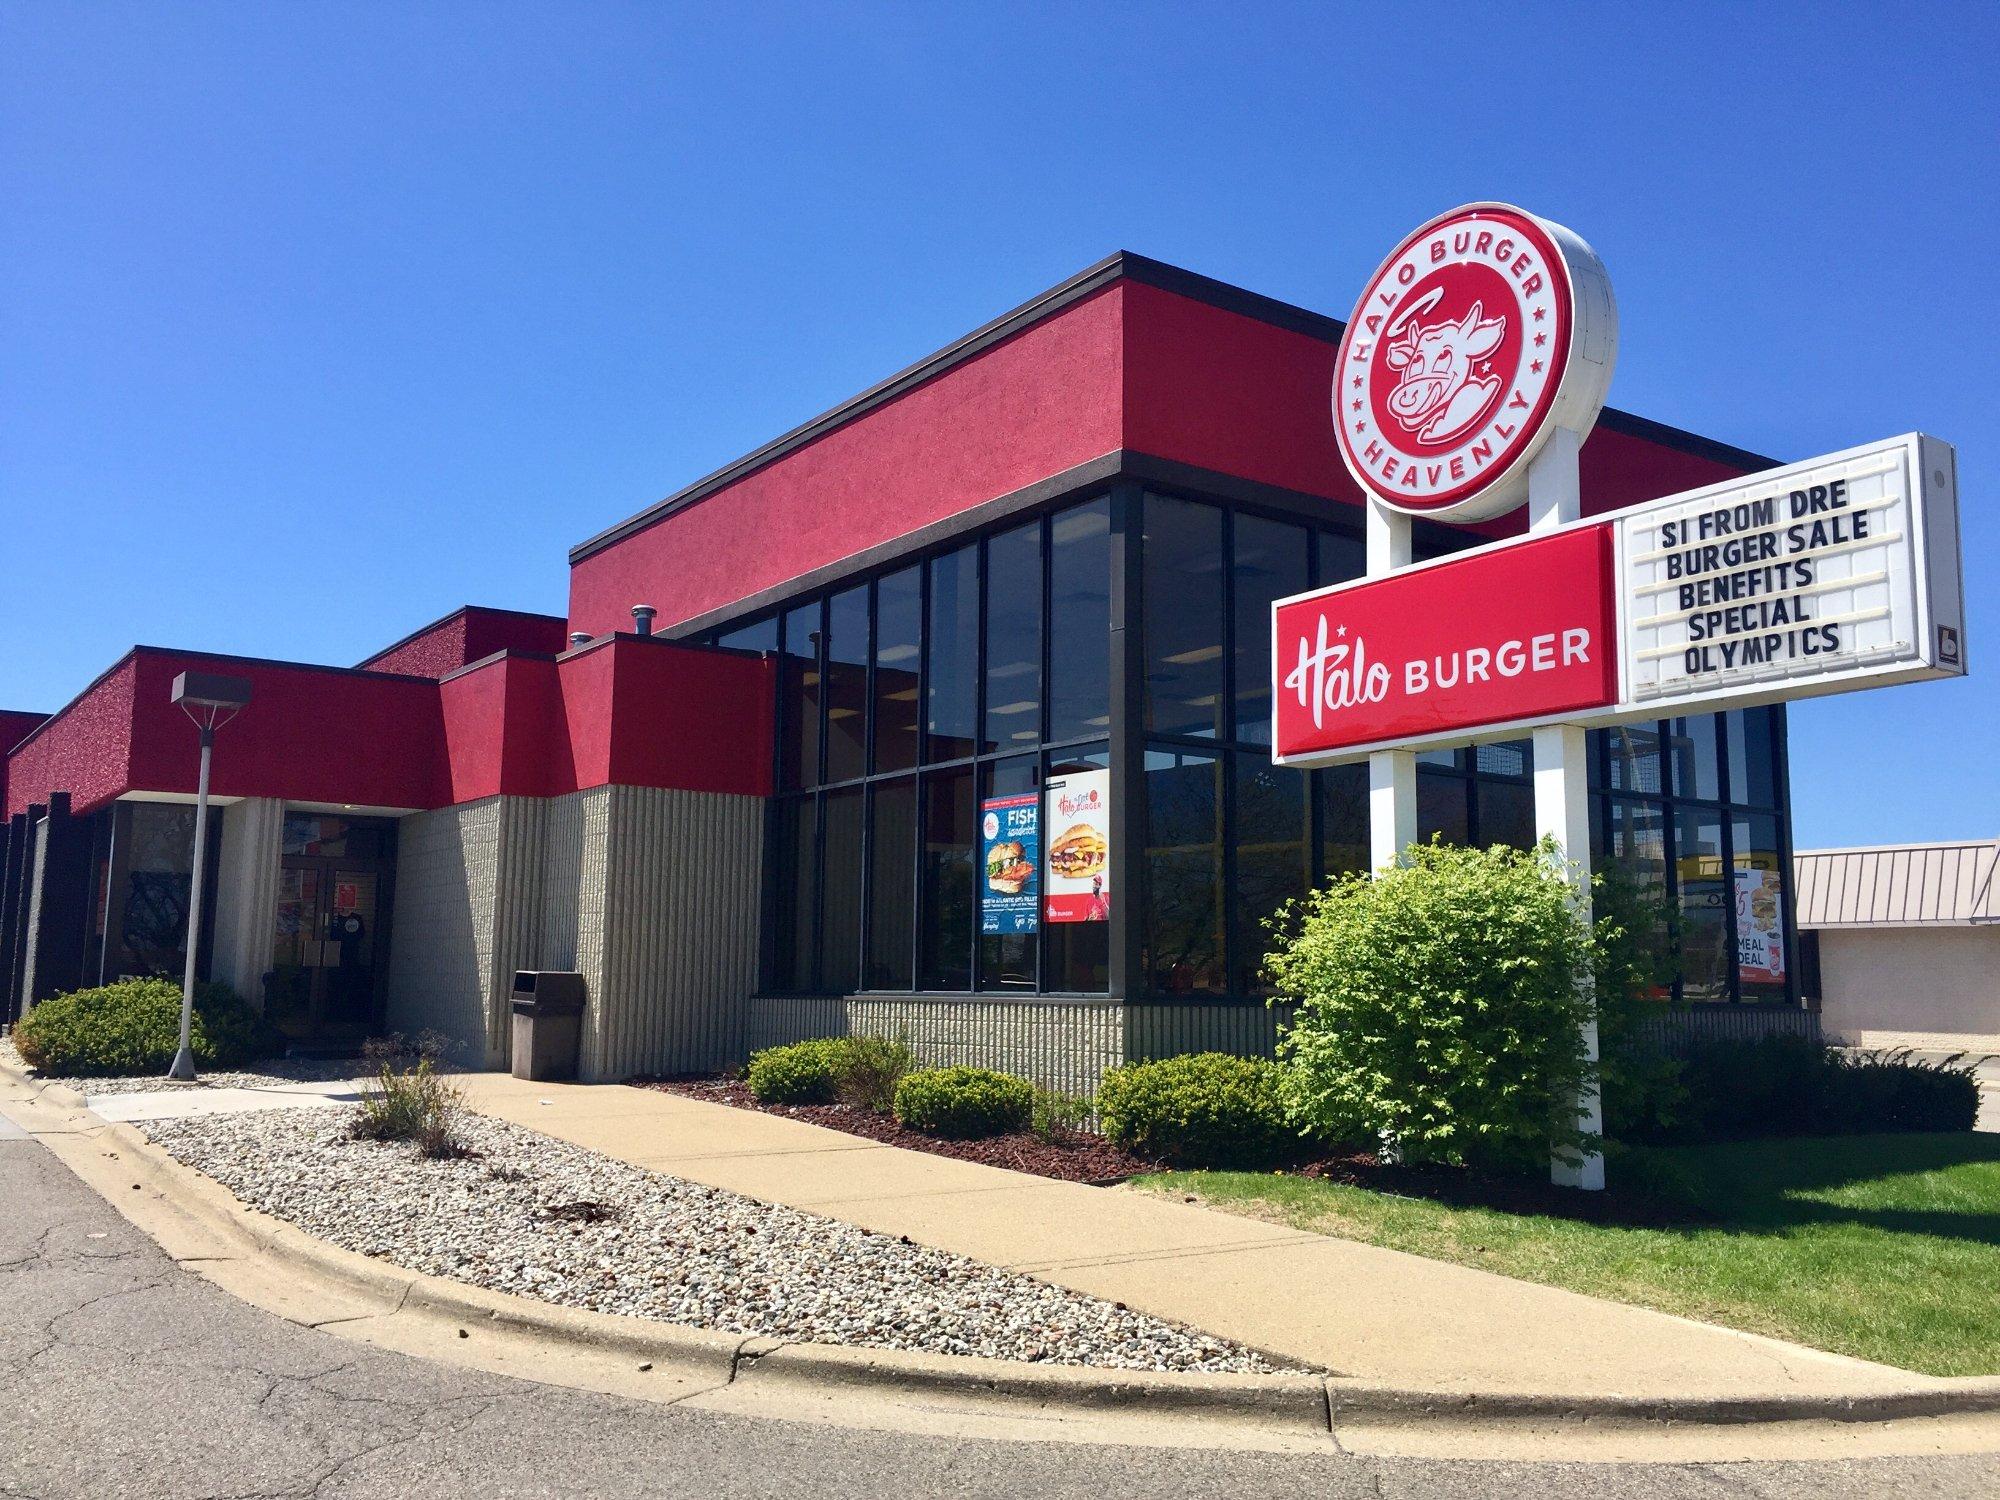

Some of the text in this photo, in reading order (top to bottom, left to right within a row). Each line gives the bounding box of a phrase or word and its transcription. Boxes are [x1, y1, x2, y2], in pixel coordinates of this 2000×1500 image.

[1353, 231, 1543, 362] HALO BURGER
[1364, 390, 1530, 488] HEAVENLY
[1699, 498, 1774, 540] FROM
[1789, 479, 1847, 518] DRE
[1667, 509, 1868, 580] BURGER SALE
[1679, 558, 1813, 610] BENEFITS
[1689, 595, 1810, 641] SPECIAL
[1284, 614, 1591, 730] Halo BURGER
[1685, 623, 1840, 674] OLYMPICS
[1008, 808, 1037, 826] FISH
[1738, 938, 1764, 951] MEAL
